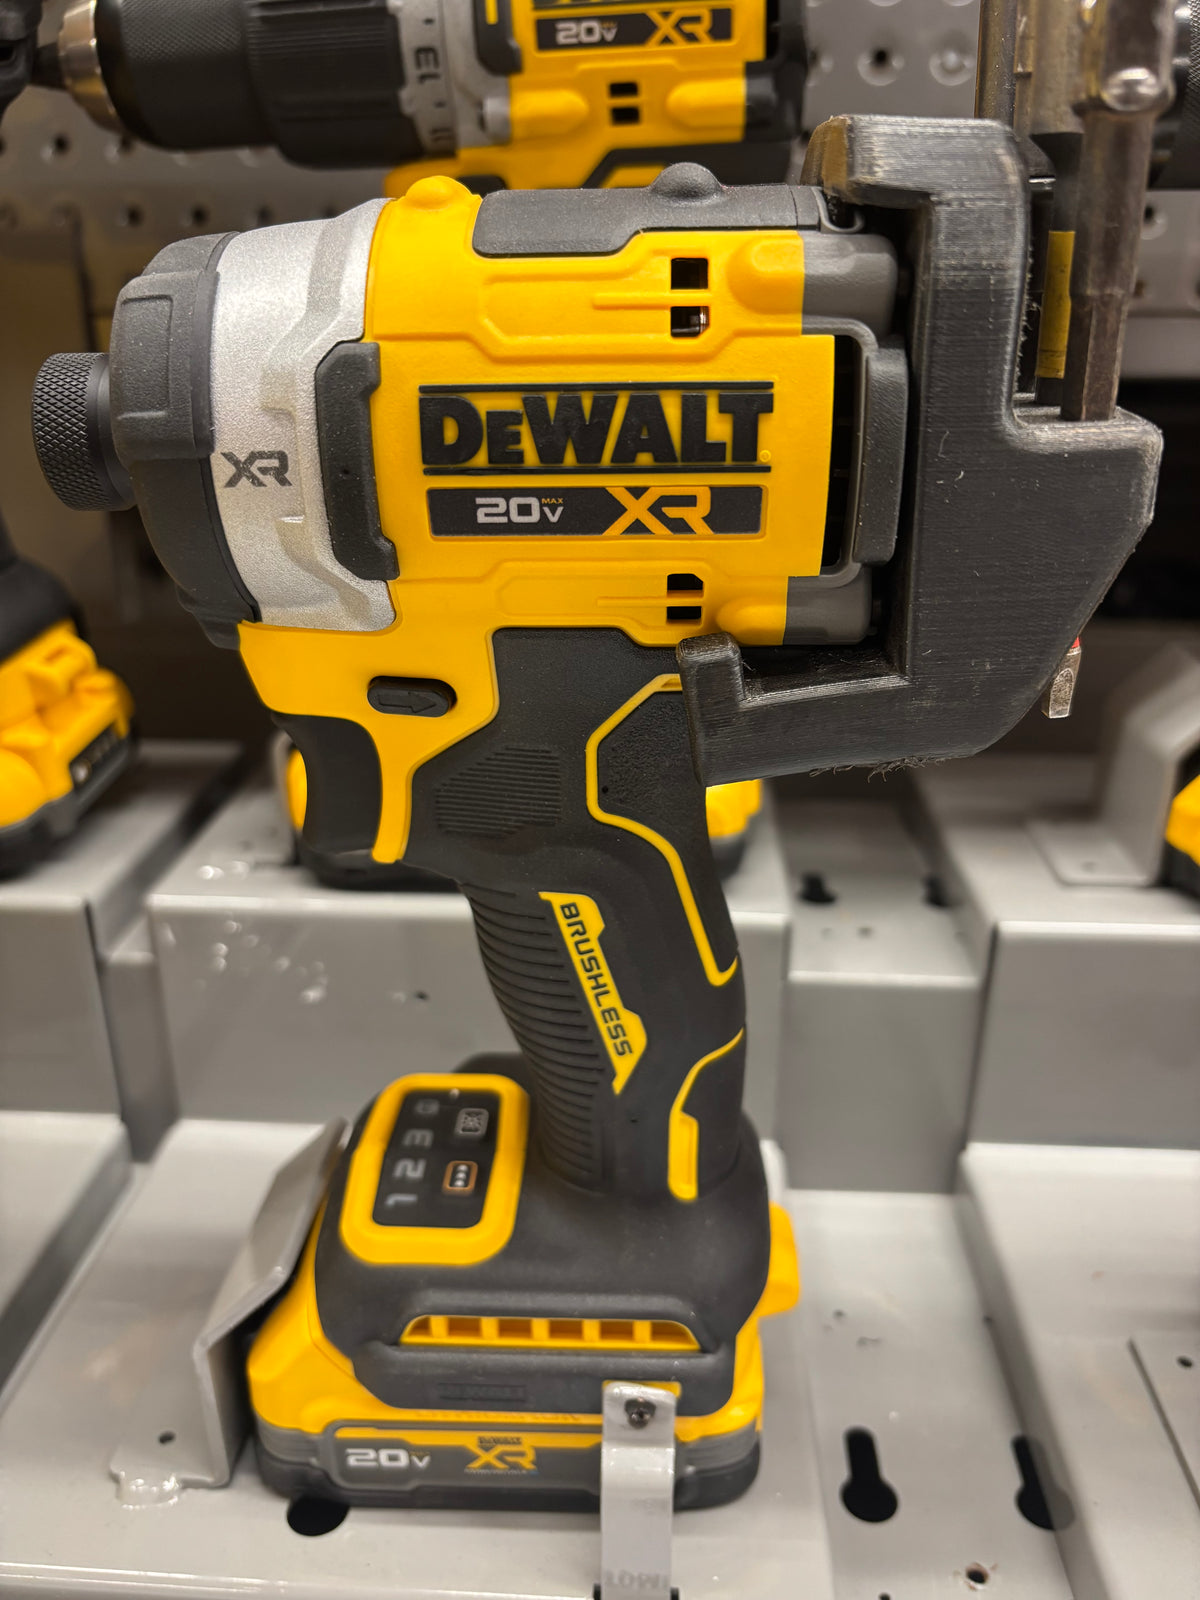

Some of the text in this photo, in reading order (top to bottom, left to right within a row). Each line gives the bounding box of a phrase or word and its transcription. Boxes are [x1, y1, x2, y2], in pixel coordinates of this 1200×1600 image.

[645, 8, 714, 46] XR
[220, 450, 293, 488] XR
[601, 486, 715, 535] XR
[560, 902, 632, 1056] BRUSHLESS
[393, 1158, 426, 1179] 2
[466, 1444, 537, 1469] XR
